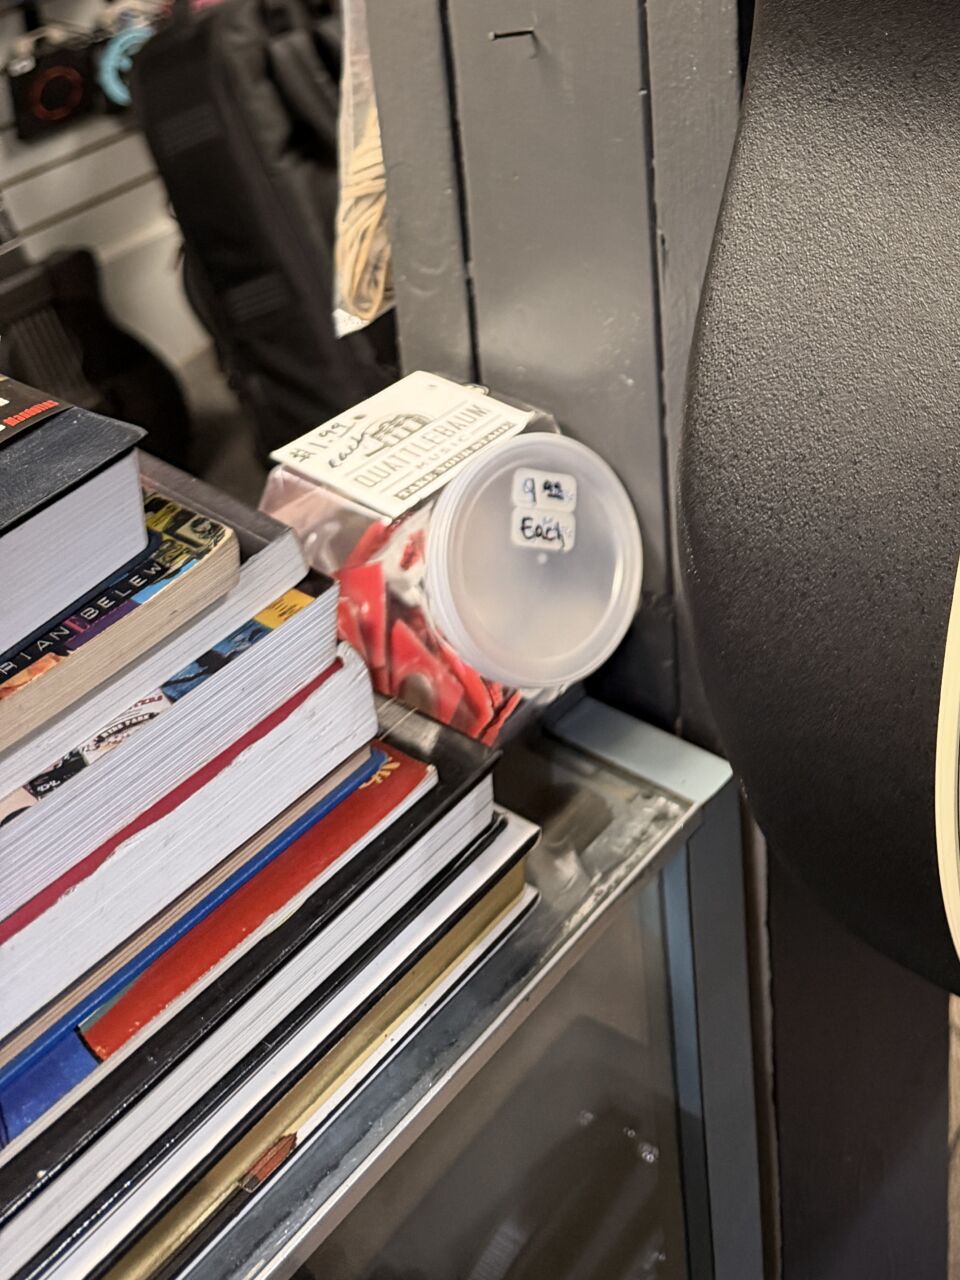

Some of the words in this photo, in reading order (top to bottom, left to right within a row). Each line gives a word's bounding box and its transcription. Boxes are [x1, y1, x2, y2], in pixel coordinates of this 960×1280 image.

[353, 403, 490, 488] QUATTLEBAUM
[415, 433, 468, 470] MUSIC
[520, 516, 566, 549] Each
[80, 562, 163, 621] BELEW
